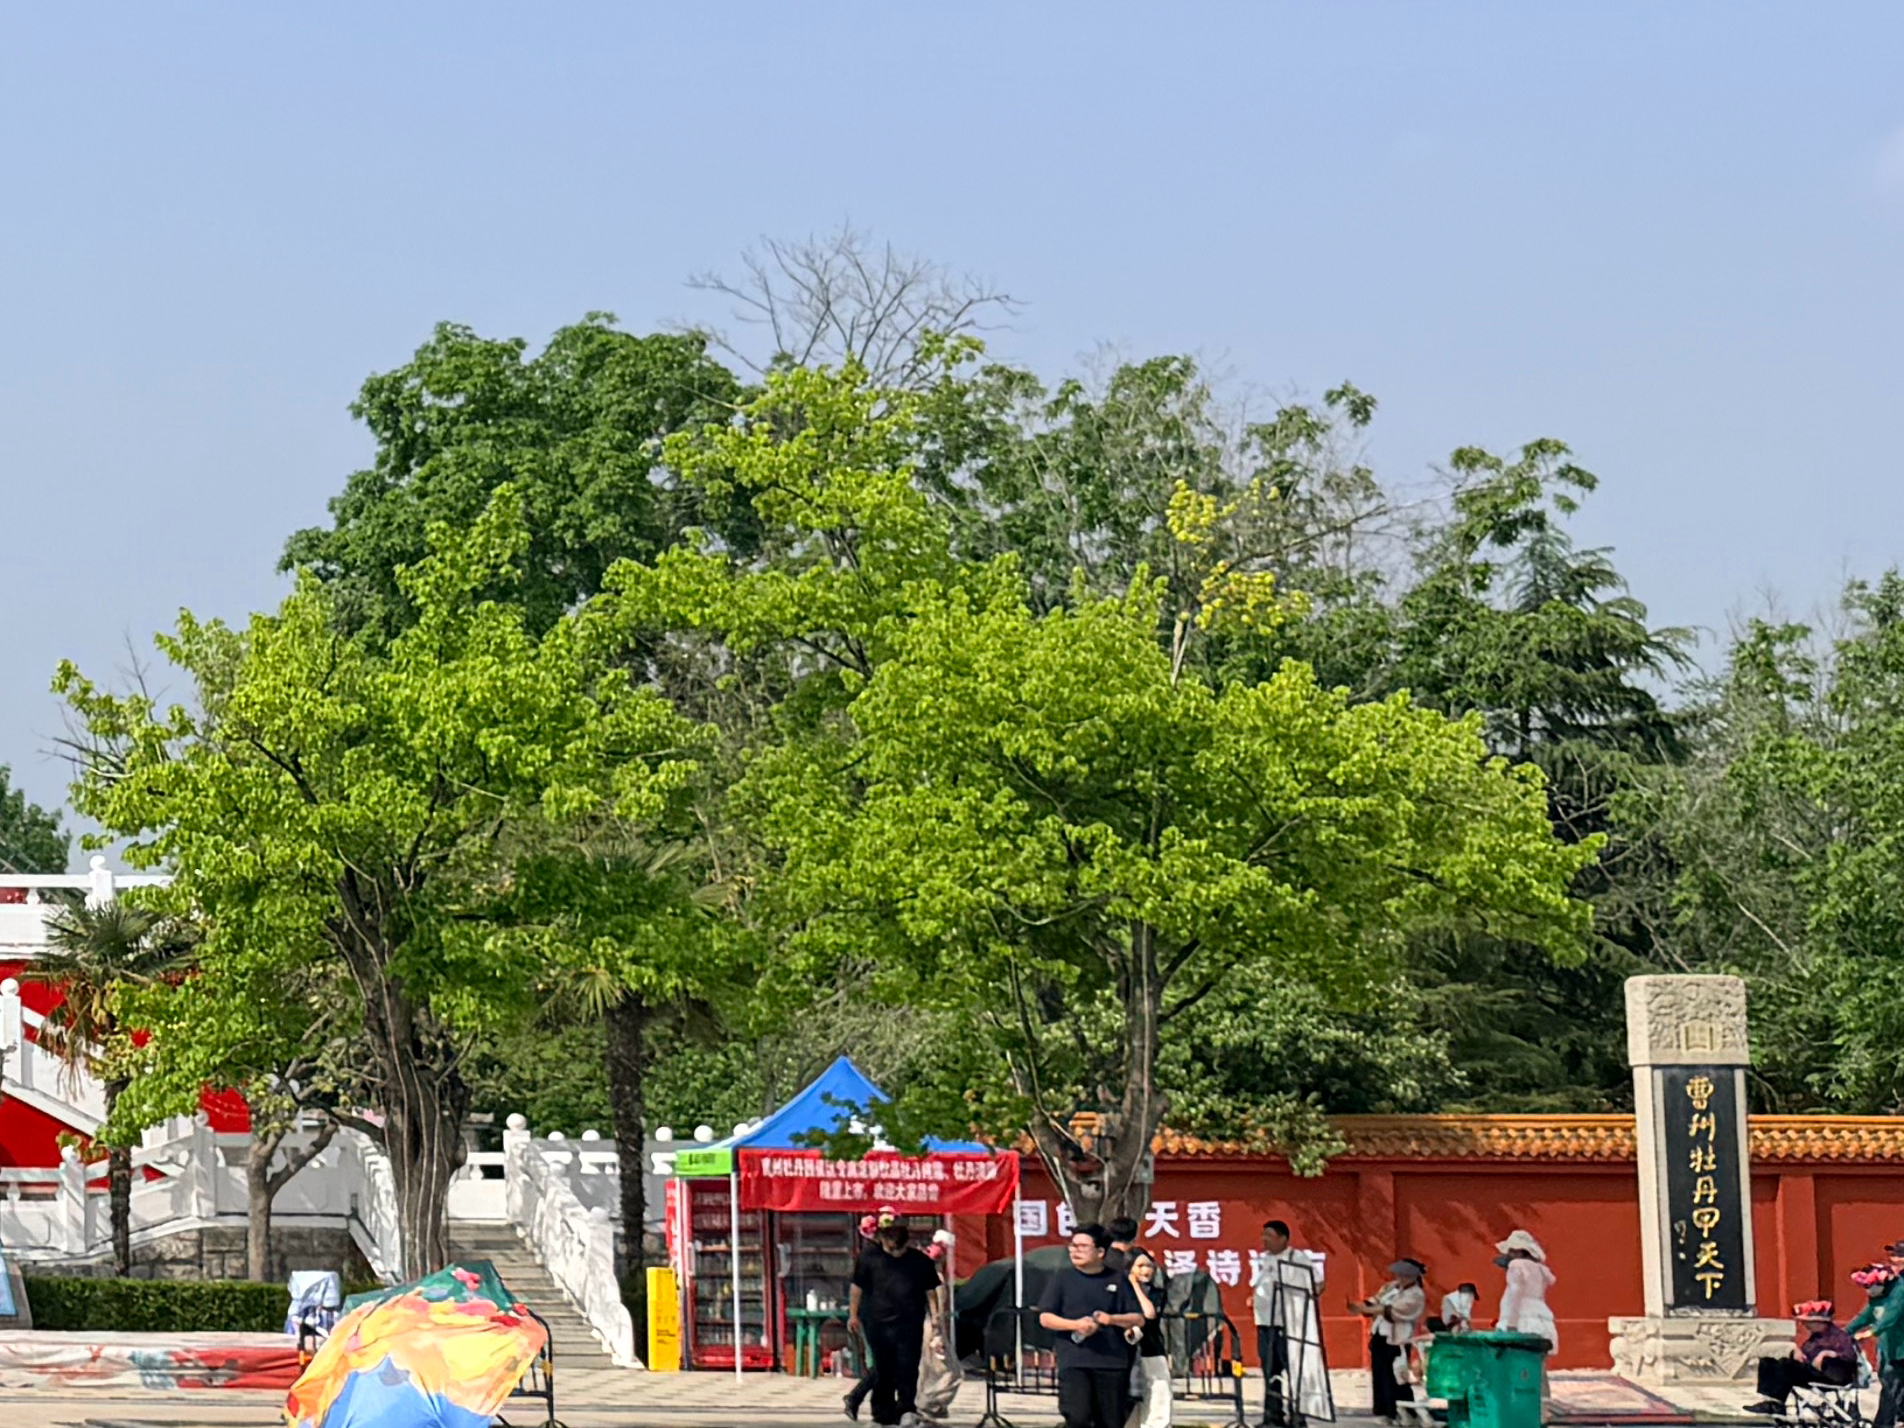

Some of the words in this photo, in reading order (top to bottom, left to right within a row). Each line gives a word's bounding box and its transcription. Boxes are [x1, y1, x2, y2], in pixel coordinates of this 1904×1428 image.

[1685, 1075, 1724, 1300] 曹州牡丹甲天下
